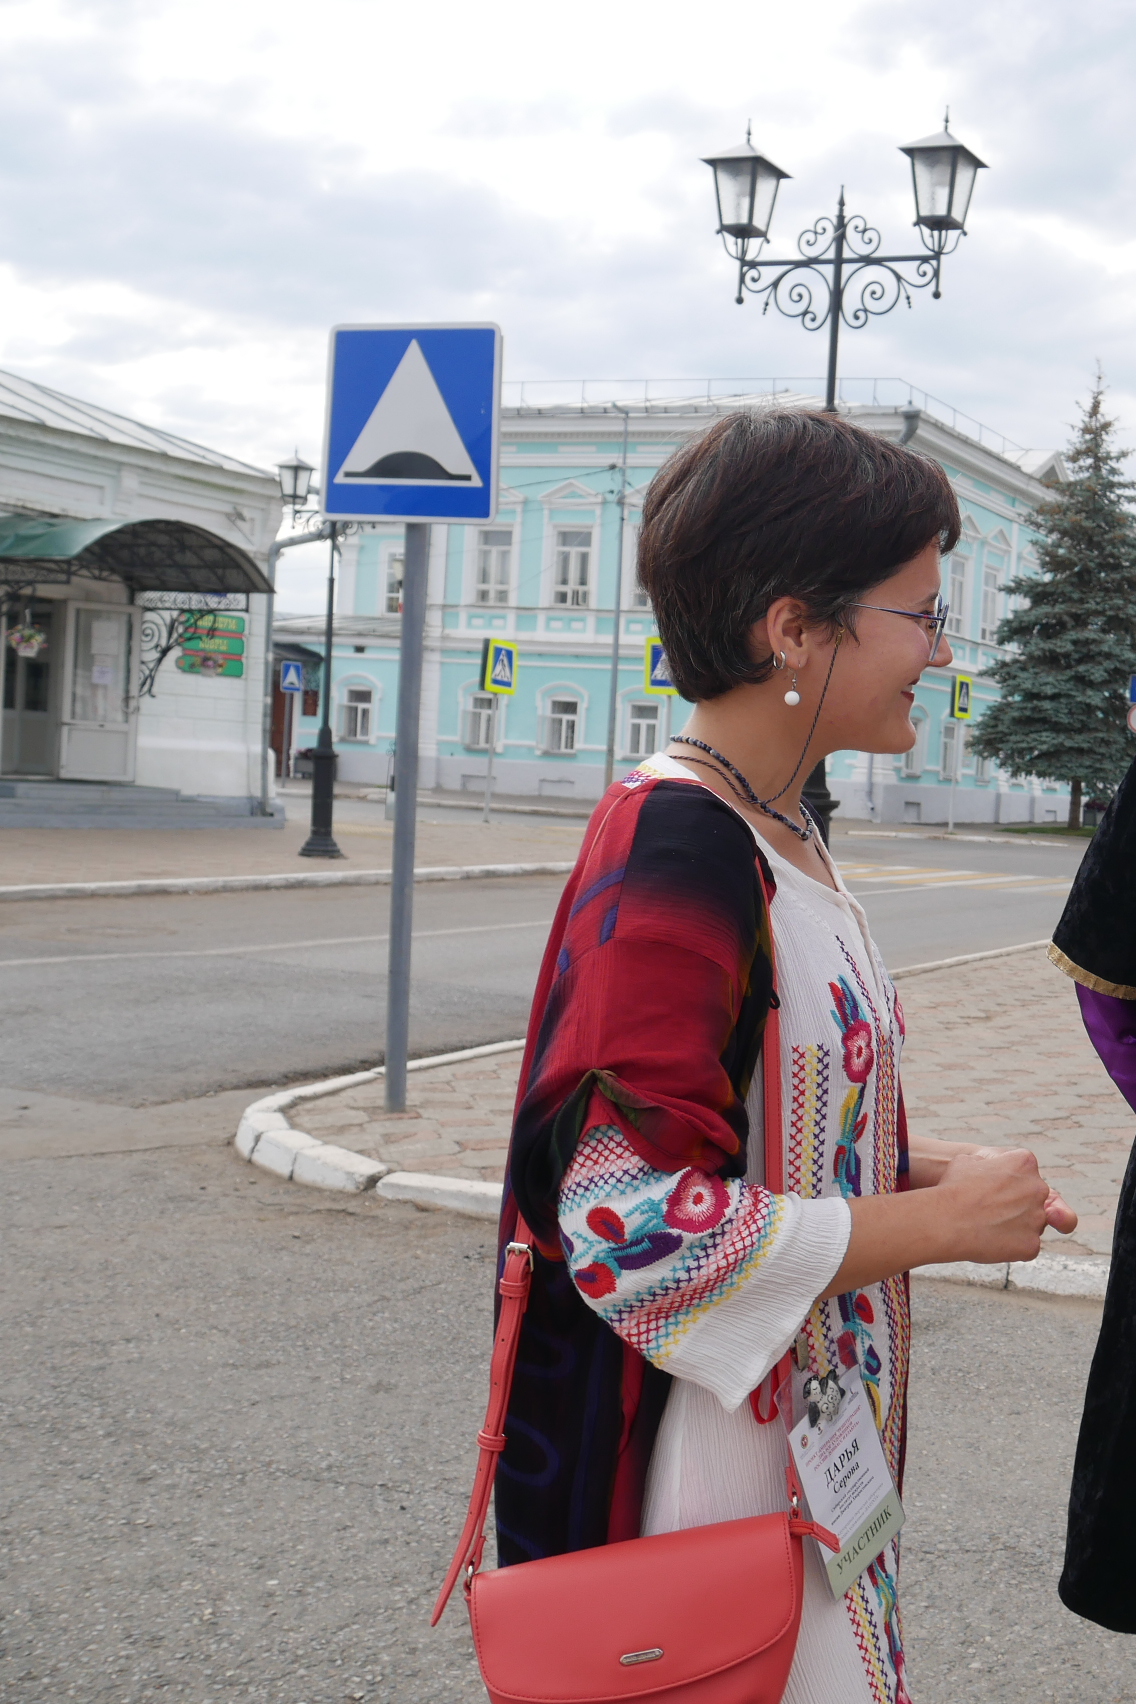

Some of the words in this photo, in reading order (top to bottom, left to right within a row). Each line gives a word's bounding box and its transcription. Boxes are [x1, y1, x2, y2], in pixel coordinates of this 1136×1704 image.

[824, 1438, 860, 1489] ДАРЬЯ
[833, 1461, 860, 1494] Серова
[837, 1505, 892, 1575] УЧАСТНИК
